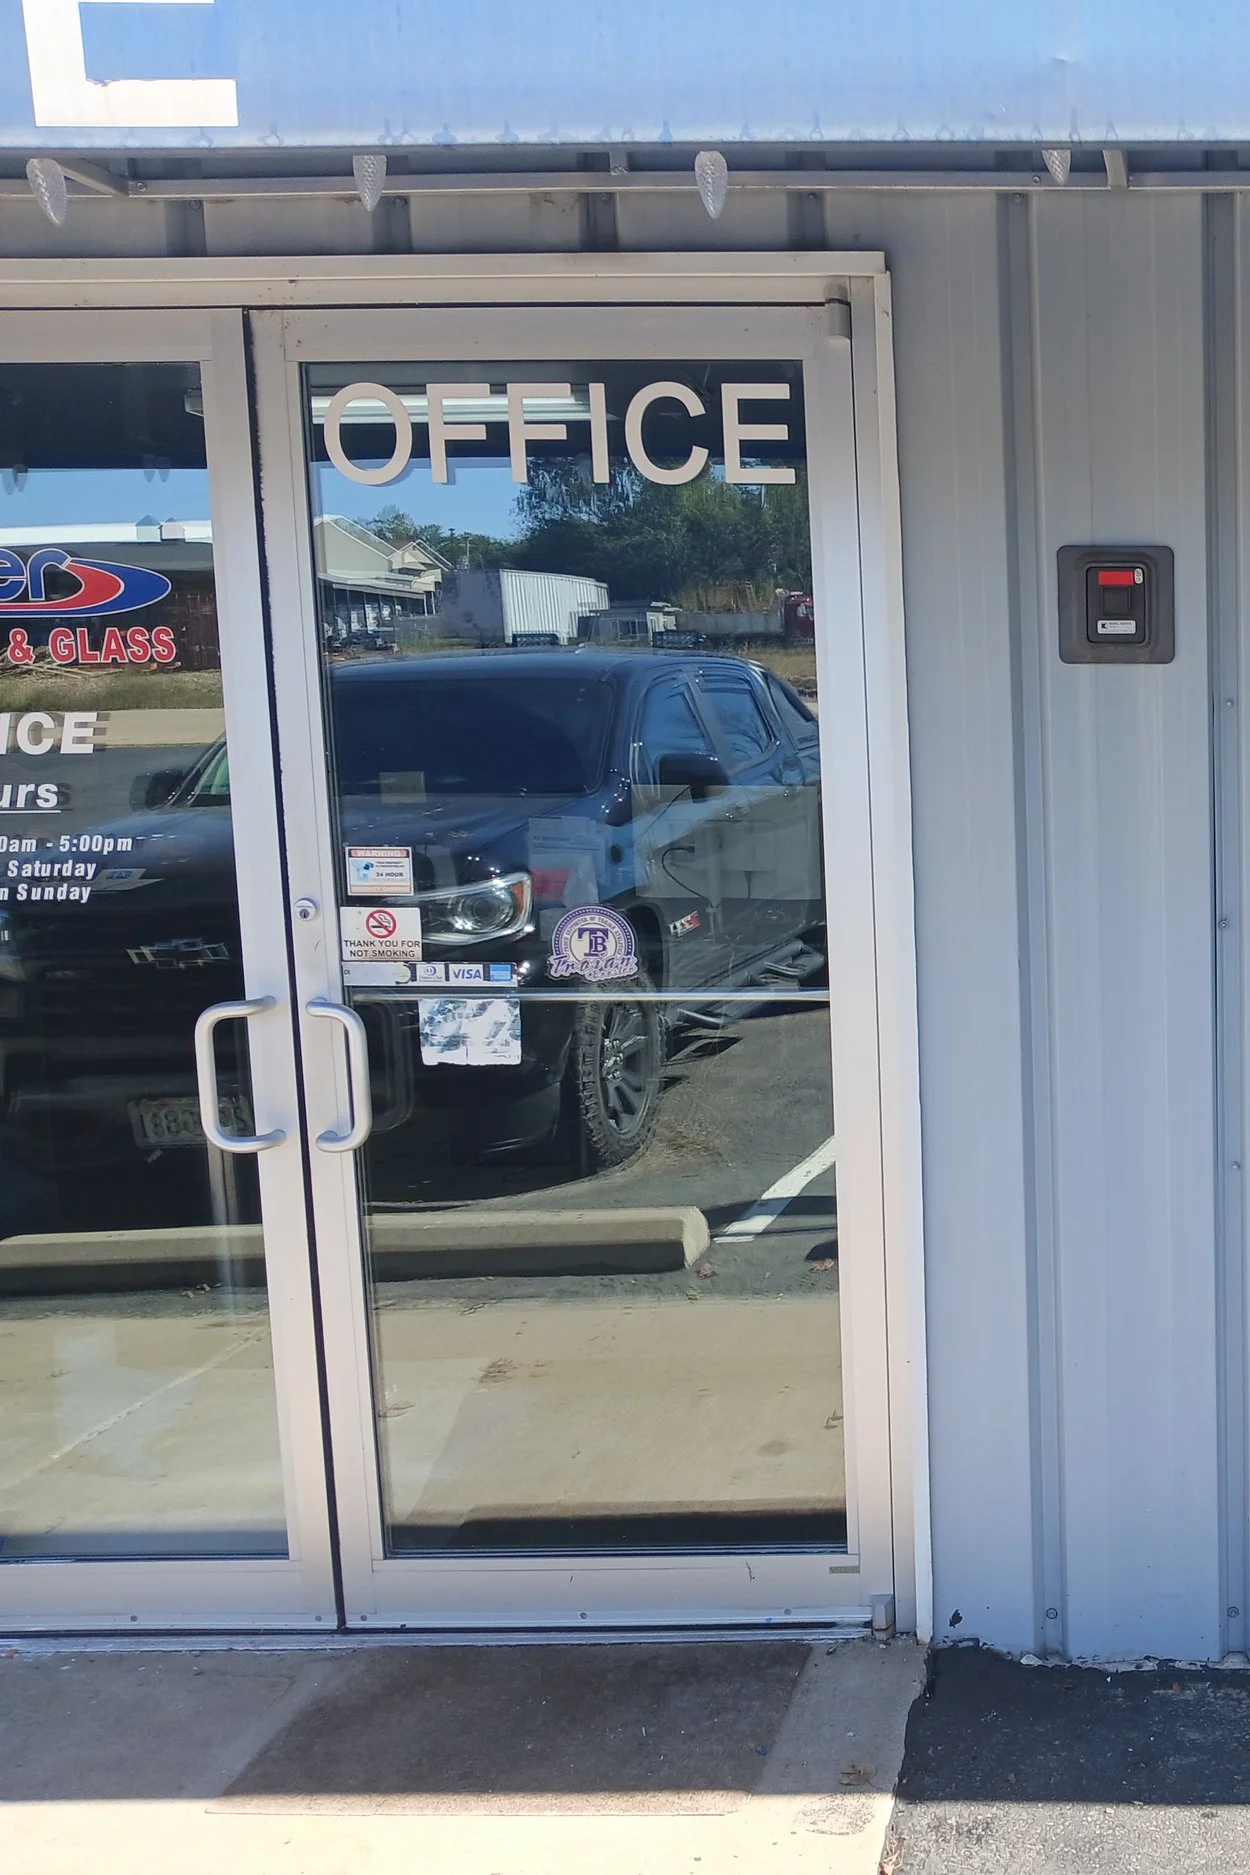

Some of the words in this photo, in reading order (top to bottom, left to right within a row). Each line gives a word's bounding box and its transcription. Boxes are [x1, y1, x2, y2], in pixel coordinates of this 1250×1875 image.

[323, 382, 797, 486] OFFICE
[7, 627, 36, 664] &
[49, 626, 177, 664] GLASS
[59, 834, 132, 856] 5:00pm
[7, 859, 97, 880] Saturday
[16, 883, 92, 904] Sunday
[343, 939, 376, 948] THANK
[378, 939, 398, 948] YOU
[401, 940, 420, 948] FOR
[349, 950, 369, 958] NOT
[371, 950, 415, 958] SMOKING
[453, 968, 482, 980] VISA
